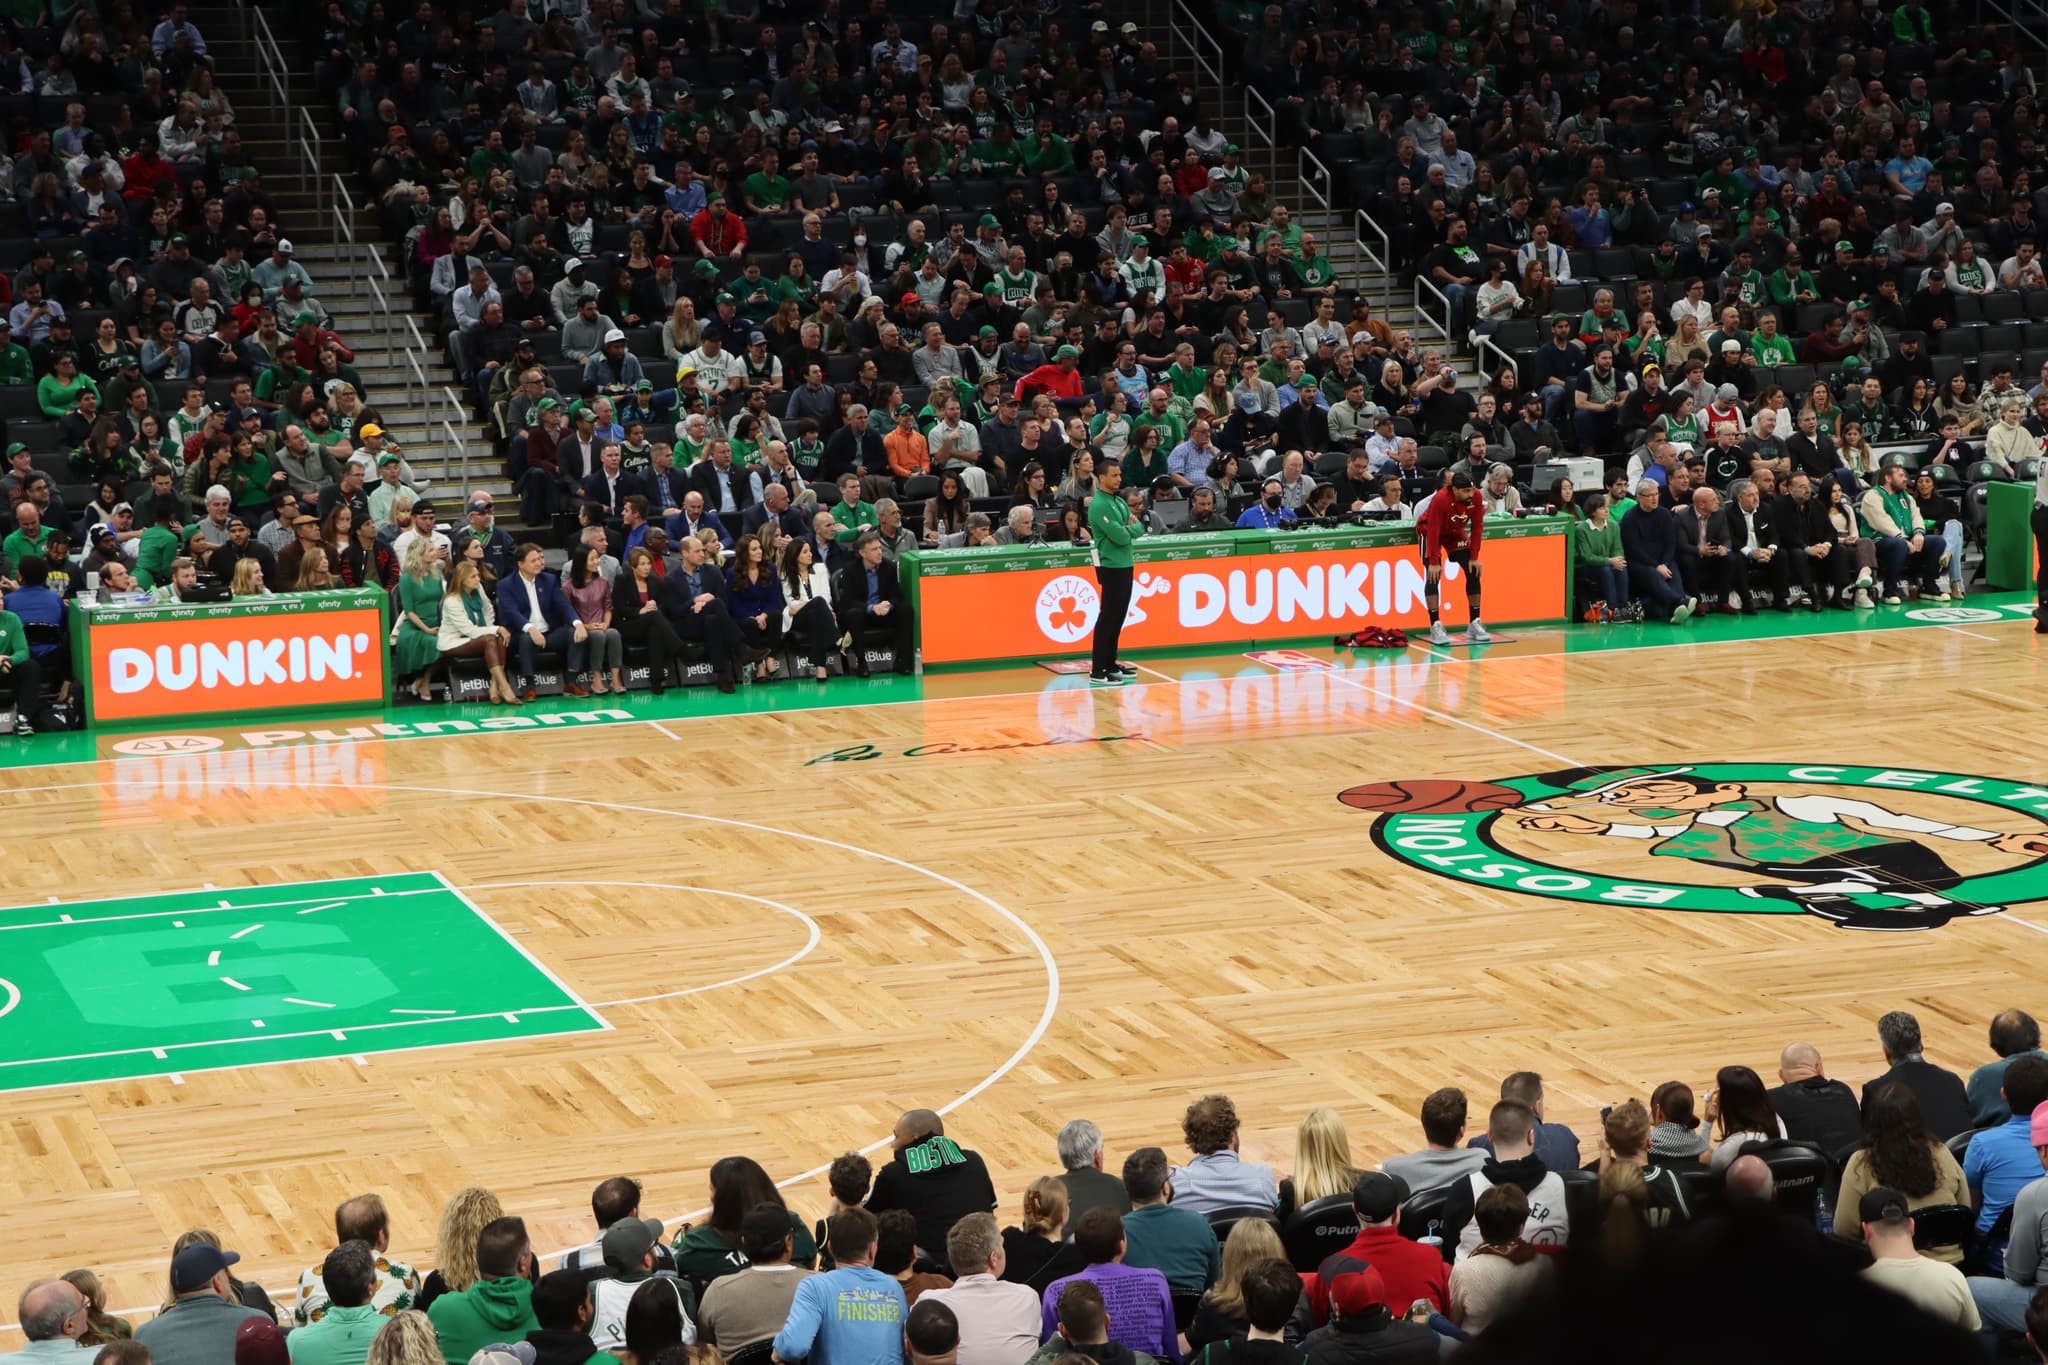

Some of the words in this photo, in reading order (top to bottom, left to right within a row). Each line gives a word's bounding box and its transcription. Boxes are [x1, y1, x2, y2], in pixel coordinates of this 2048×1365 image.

[1041, 579, 1095, 608] CELTICS
[109, 632, 369, 694] DUNKIN'
[240, 708, 635, 747] Putnam
[1787, 767, 2048, 809] CELT
[1396, 818, 1687, 904] BOSTON
[838, 1302, 900, 1323] FINISHER
